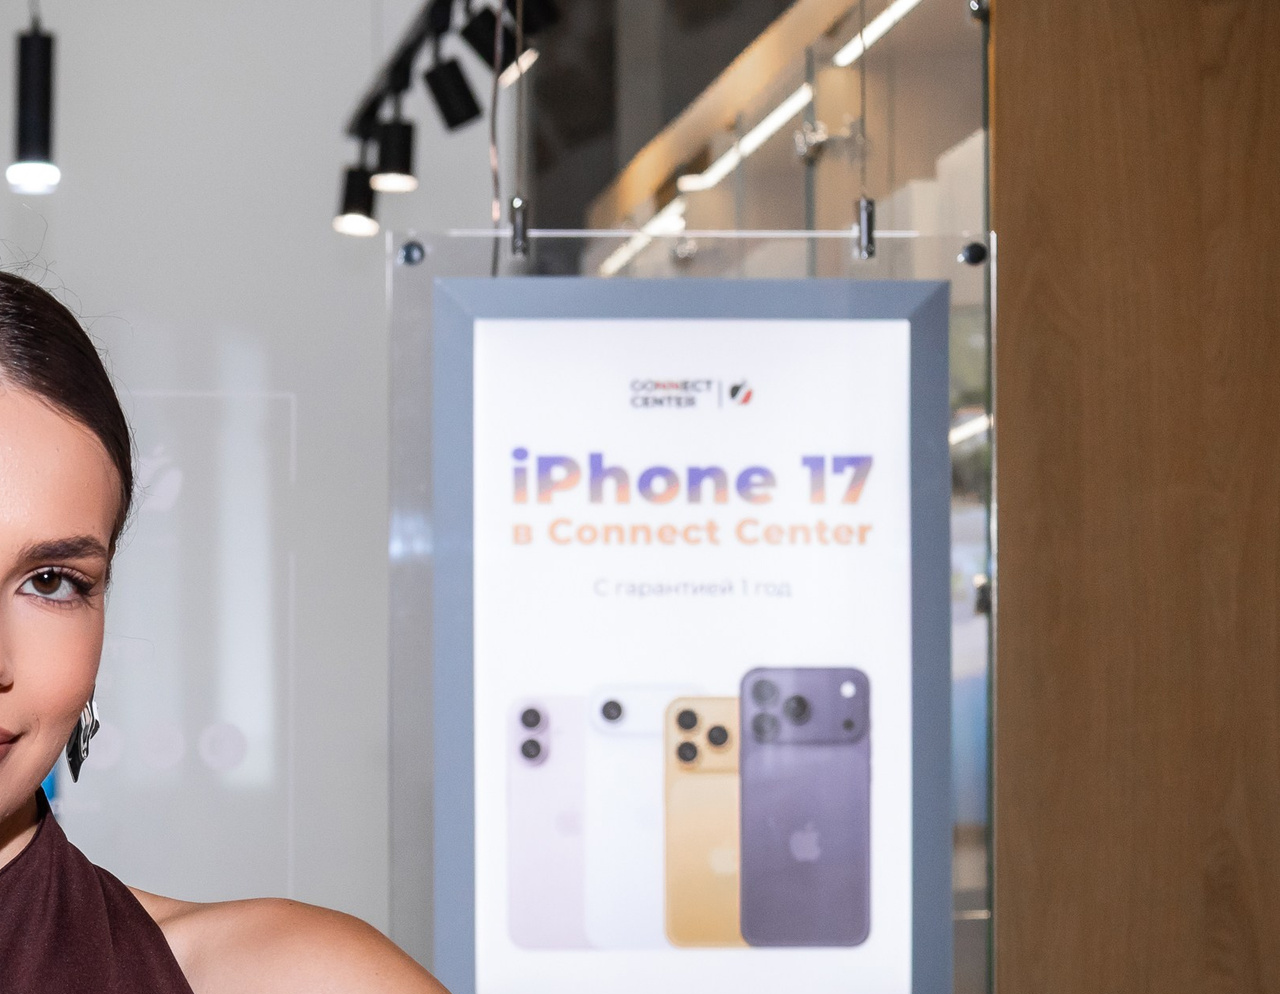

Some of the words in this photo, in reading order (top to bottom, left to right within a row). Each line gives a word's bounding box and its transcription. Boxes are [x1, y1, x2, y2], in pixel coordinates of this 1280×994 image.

[630, 396, 697, 408] CENTER
[511, 447, 777, 504] iPhone
[801, 455, 874, 504] 17
[548, 518, 720, 545] Connect
[735, 518, 873, 545] Center
[615, 577, 734, 600] гарантией
[740, 578, 748, 596] 1
[754, 582, 793, 600] год
